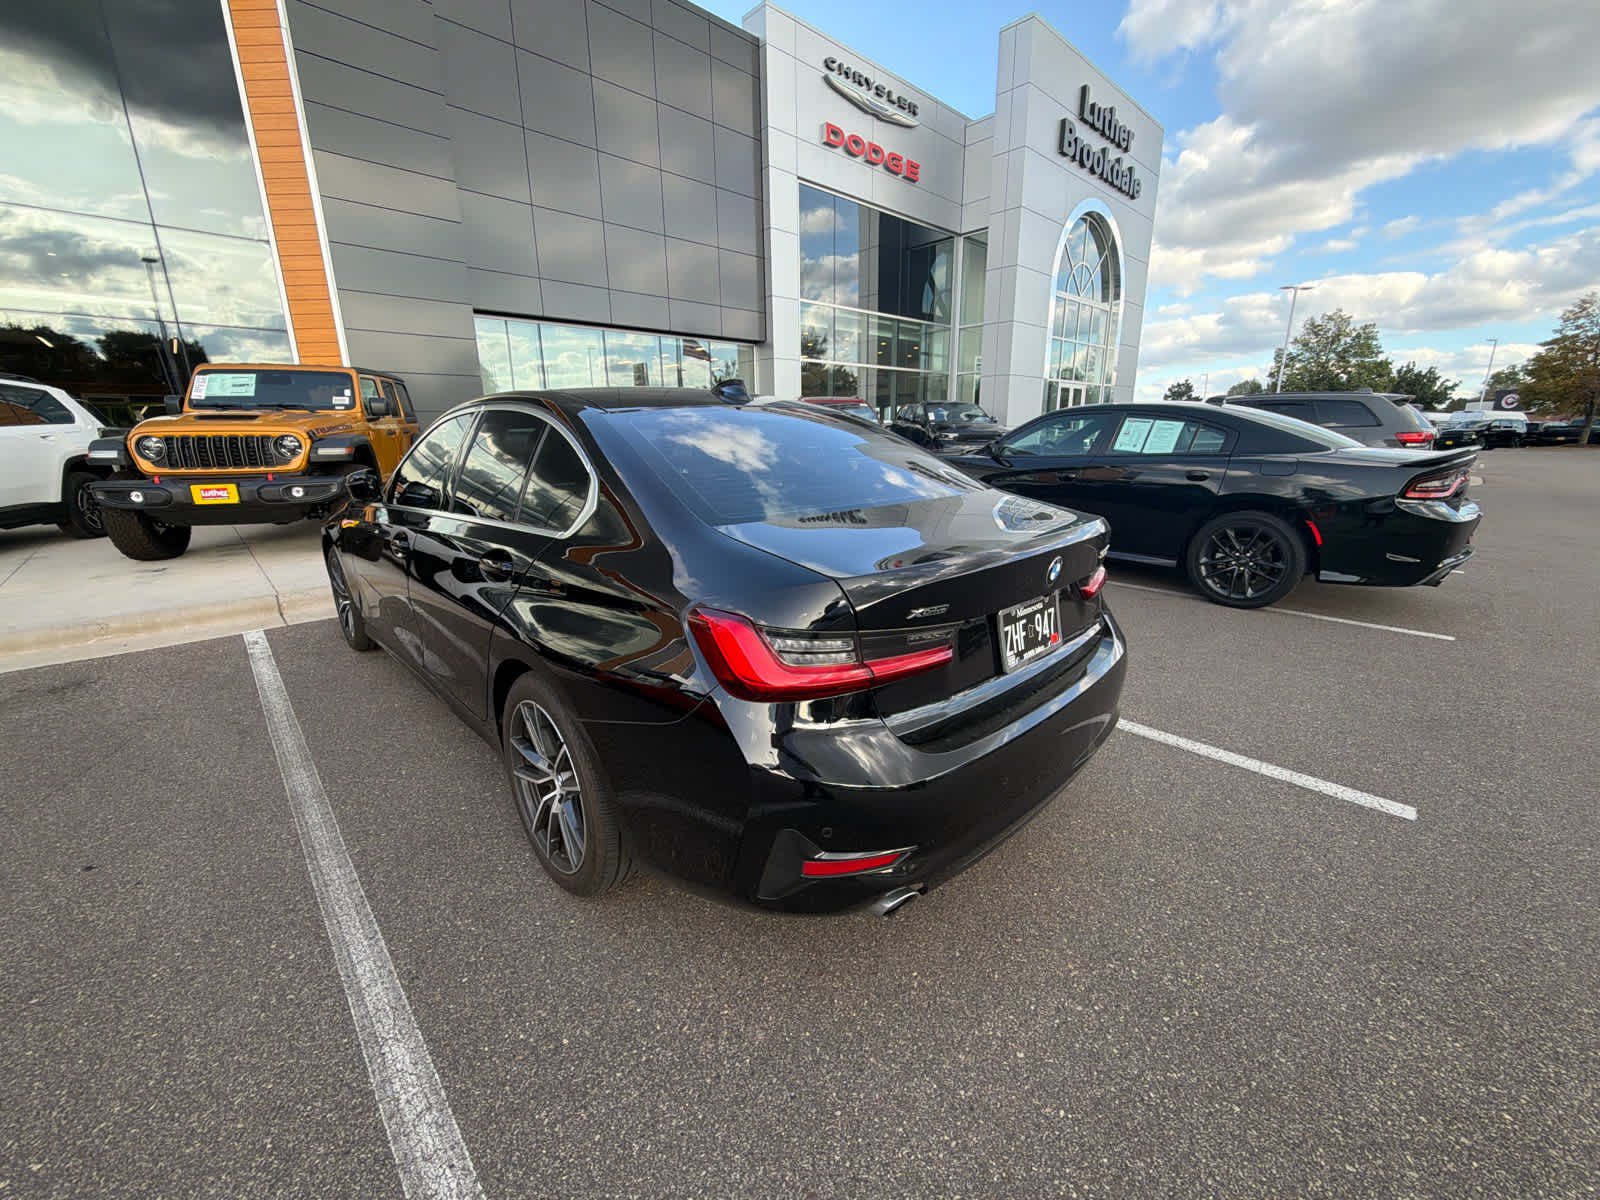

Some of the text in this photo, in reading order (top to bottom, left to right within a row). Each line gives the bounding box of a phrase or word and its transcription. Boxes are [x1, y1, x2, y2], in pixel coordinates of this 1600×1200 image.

[823, 56, 919, 117] CHRYSLER
[1078, 83, 1135, 154] Luther
[821, 121, 921, 183] DODGE
[1057, 117, 1142, 200] Brookdale
[1004, 618, 1027, 656] ZHF
[1034, 607, 1055, 641] 947
